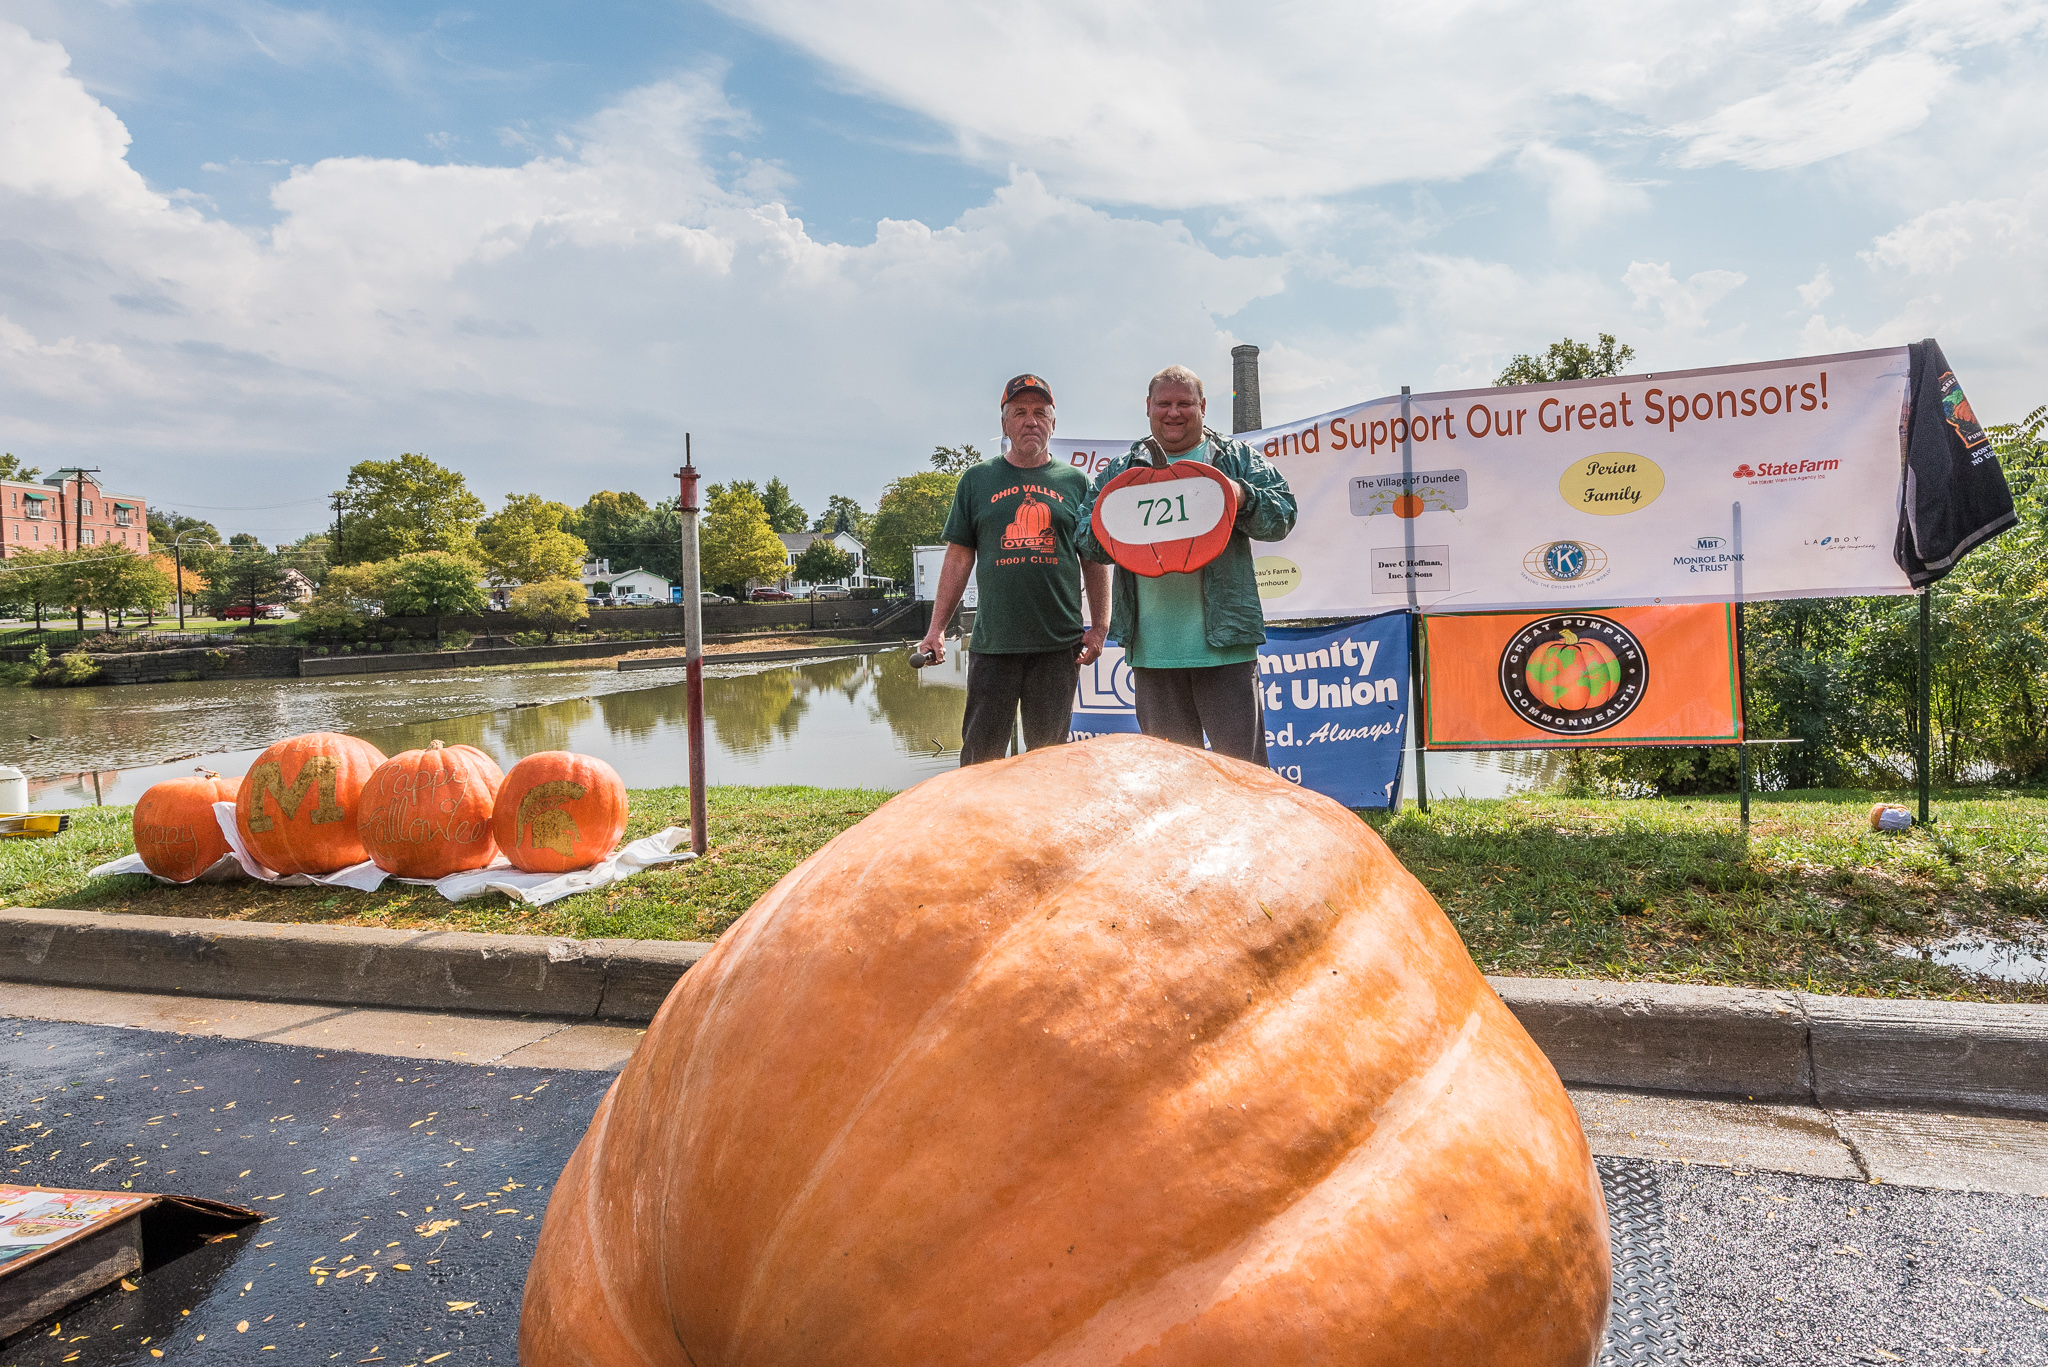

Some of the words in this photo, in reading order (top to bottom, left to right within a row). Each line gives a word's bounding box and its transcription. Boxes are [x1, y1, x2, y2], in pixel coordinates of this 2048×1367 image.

[1263, 422, 1320, 458] and
[1330, 407, 1457, 454] Support
[1466, 403, 1527, 438] Our
[1538, 392, 1634, 433] Great
[1644, 372, 1829, 432] Sponsors!
[1070, 451, 1111, 474] Ple
[1586, 461, 1637, 476] Perion
[1971, 456, 1984, 467] NO
[1356, 480, 1374, 489] The
[1376, 477, 1407, 487] Village
[1410, 475, 1420, 484] of
[1422, 473, 1460, 484] Dundee
[990, 486, 1019, 503] OHIO
[1022, 484, 1064, 503] VALLEY
[1583, 486, 1642, 504] Family
[1137, 494, 1190, 526] 721
[1004, 537, 1054, 548] OVGPG
[1550, 543, 1580, 554] KIWANIS
[1697, 540, 1719, 549] MBT
[1030, 555, 1058, 565] CLUB
[1377, 561, 1397, 569] Dave
[1398, 560, 1405, 568] C
[1406, 559, 1443, 567] Hoffman,
[1547, 556, 1583, 578] INTERNATIONAL
[1556, 549, 1575, 573] K
[1690, 564, 1699, 573] &
[1254, 569, 1272, 577] eau's
[1388, 572, 1404, 580] Inc.
[1405, 571, 1413, 579] &
[1520, 571, 1539, 586] SERVING
[1596, 569, 1611, 582] WORLD
[1257, 580, 1289, 588] eenhouse
[1510, 623, 1550, 664] GREAT
[1562, 619, 1637, 661] PUMPKIN
[1258, 637, 1380, 676] munity
[1291, 676, 1399, 710] Union
[1513, 684, 1637, 726] COMMONWEALTH
[1305, 714, 1405, 746] Always!
[247, 755, 345, 833] M
[359, 796, 487, 861] Hallowee
